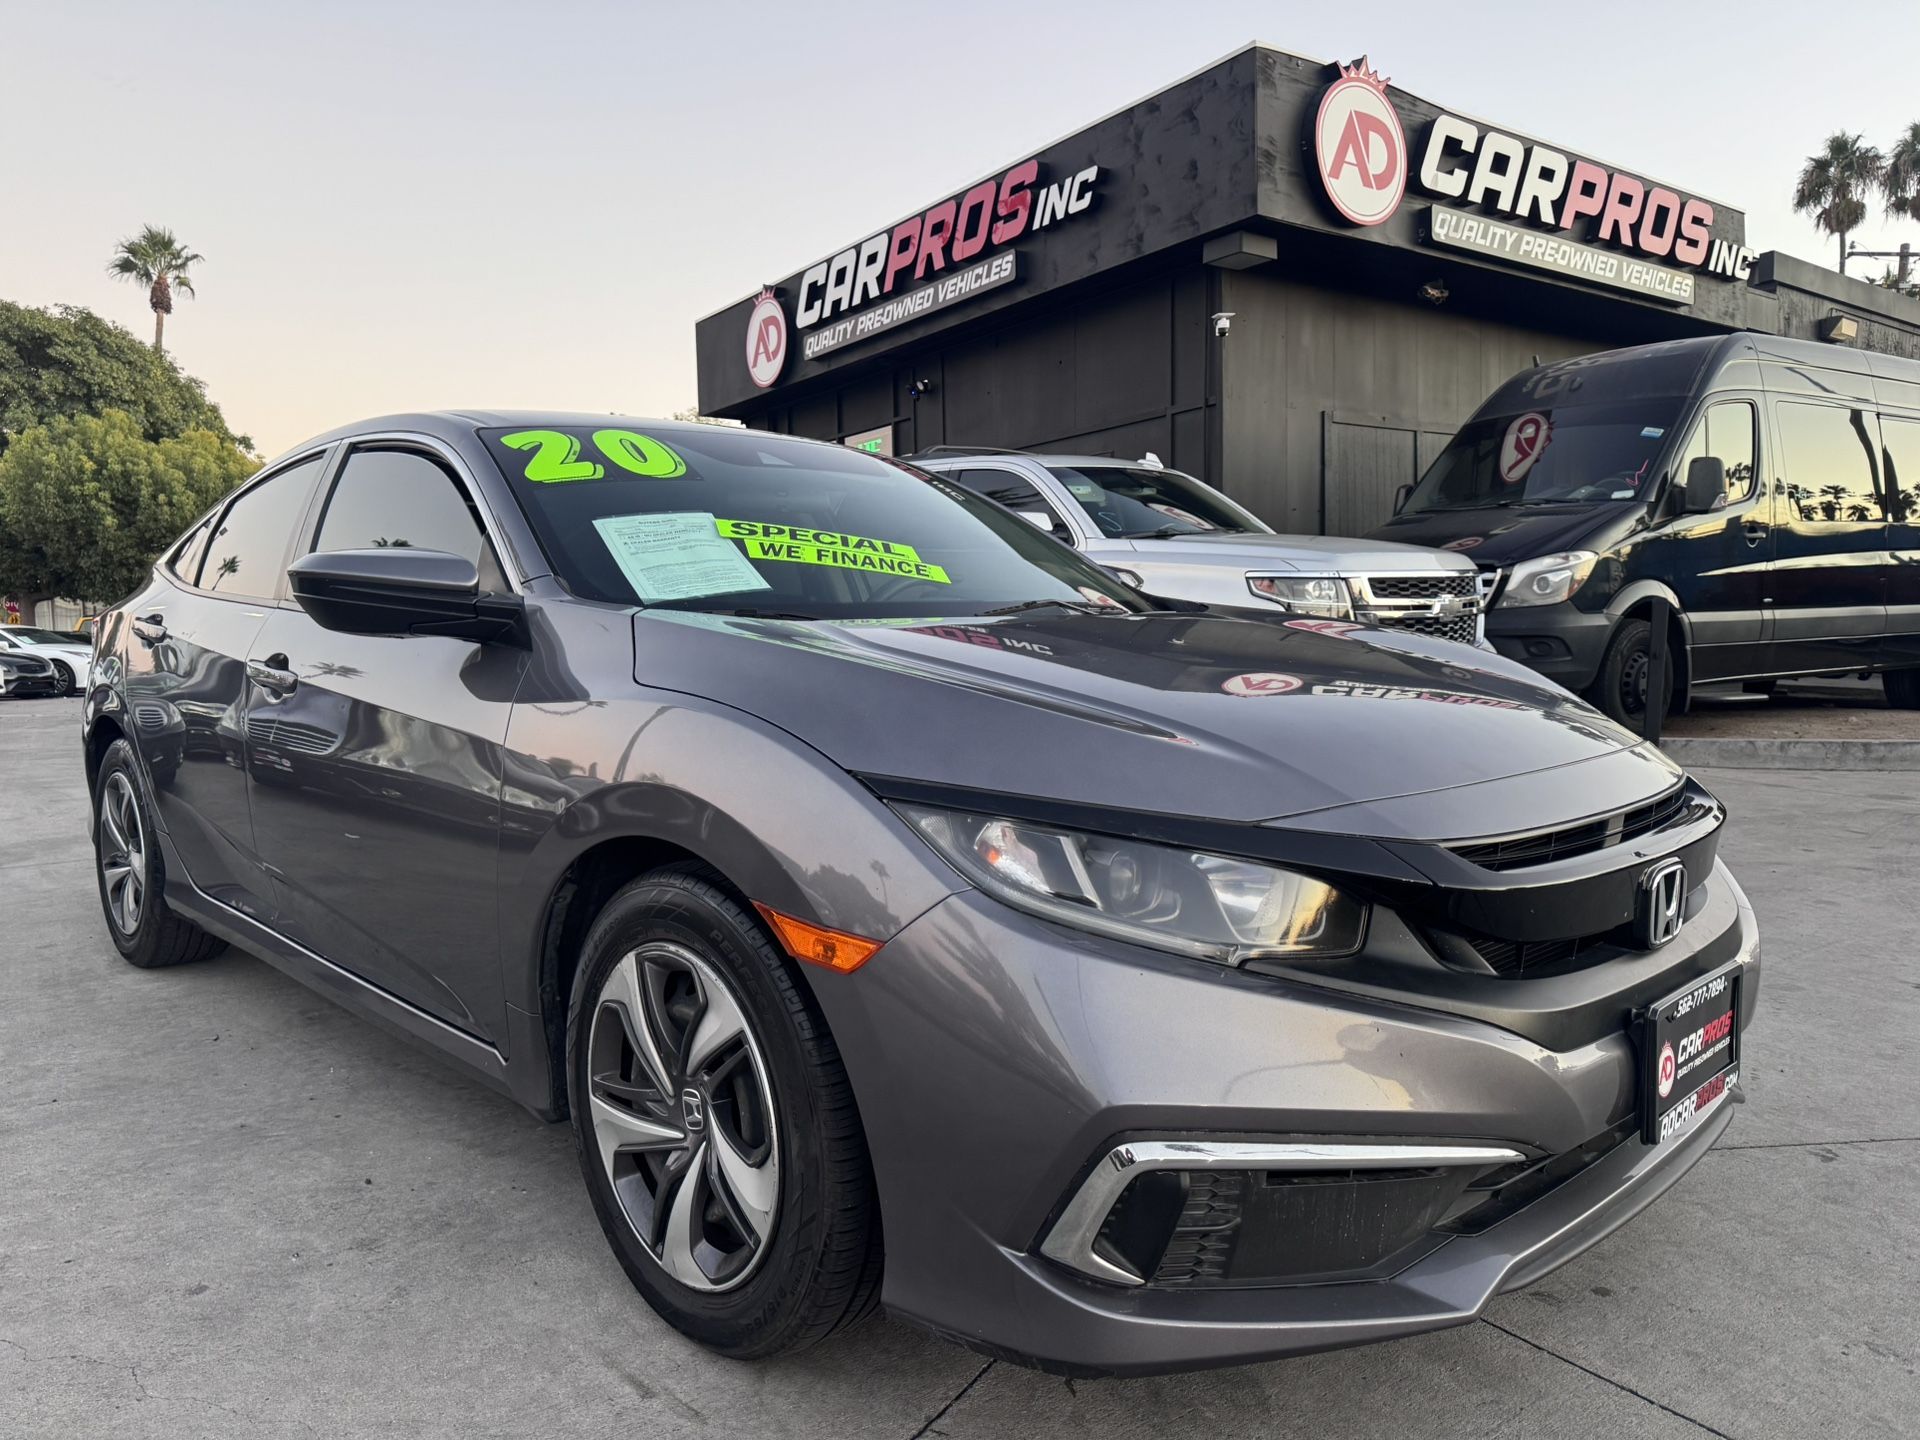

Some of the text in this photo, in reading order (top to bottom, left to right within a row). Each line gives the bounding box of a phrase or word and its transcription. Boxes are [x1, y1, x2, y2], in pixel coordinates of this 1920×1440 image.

[1328, 109, 1397, 190] AD
[1032, 165, 1098, 231] INC
[1434, 212, 1519, 252] QUALITY
[1622, 262, 1693, 298] VEHICLES
[1708, 238, 1754, 281] INC
[805, 322, 854, 356] QUALITY
[938, 254, 1014, 302] VEHICLES
[752, 315, 782, 369] AD
[500, 430, 687, 484] 20
[730, 522, 906, 557] SPECIAL
[759, 541, 931, 578] WE FINANCE
[1677, 975, 1725, 1017] 562-777-7894
